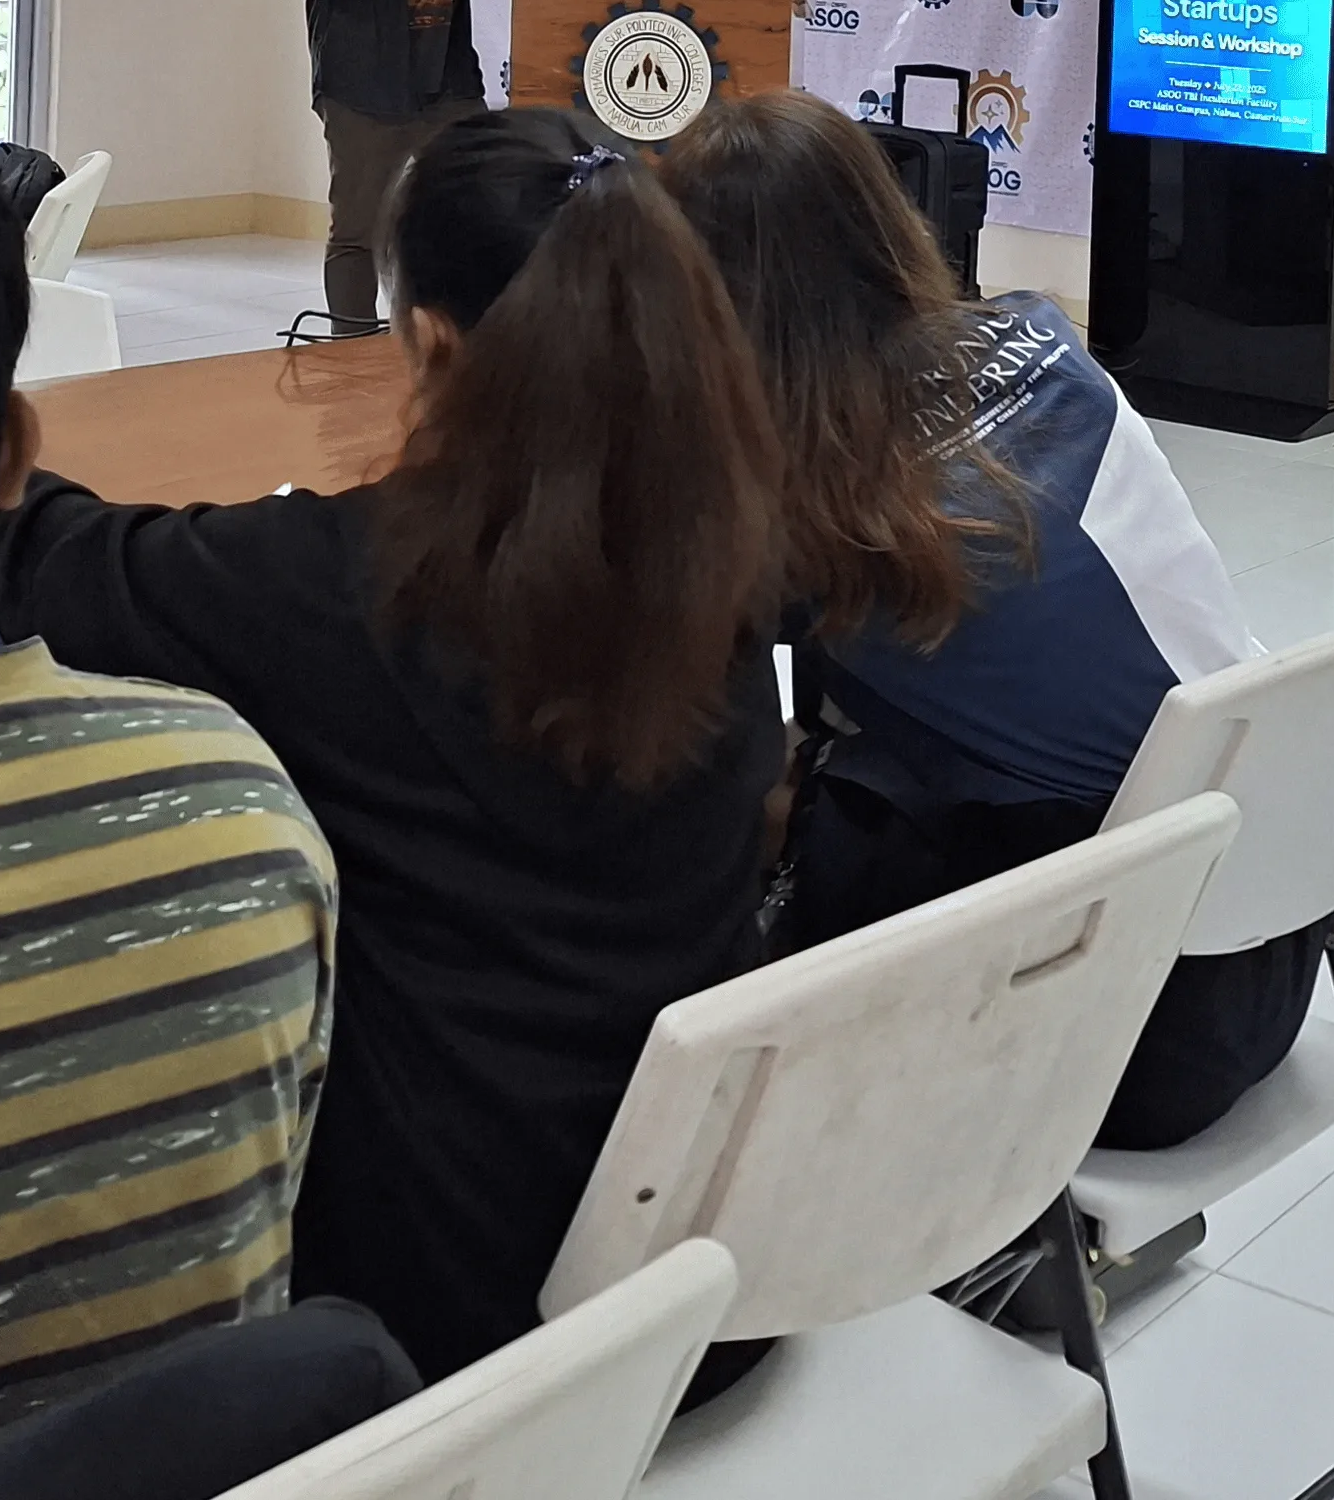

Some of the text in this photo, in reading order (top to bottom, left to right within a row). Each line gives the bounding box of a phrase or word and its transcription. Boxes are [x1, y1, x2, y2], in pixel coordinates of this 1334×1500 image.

[1138, 27, 1303, 59] Session & Workshop
[590, 19, 704, 105] CAMARINES SUR POLYTECHNIC COLLEGES
[1129, 99, 1151, 109] CSPC
[1157, 89, 1181, 100] ASOG
[647, 119, 667, 133] CAM
[672, 104, 693, 124] SUR
[988, 168, 1021, 190] OG
[1027, 367, 1044, 384] THE
[996, 392, 1035, 423] CHAPTER
